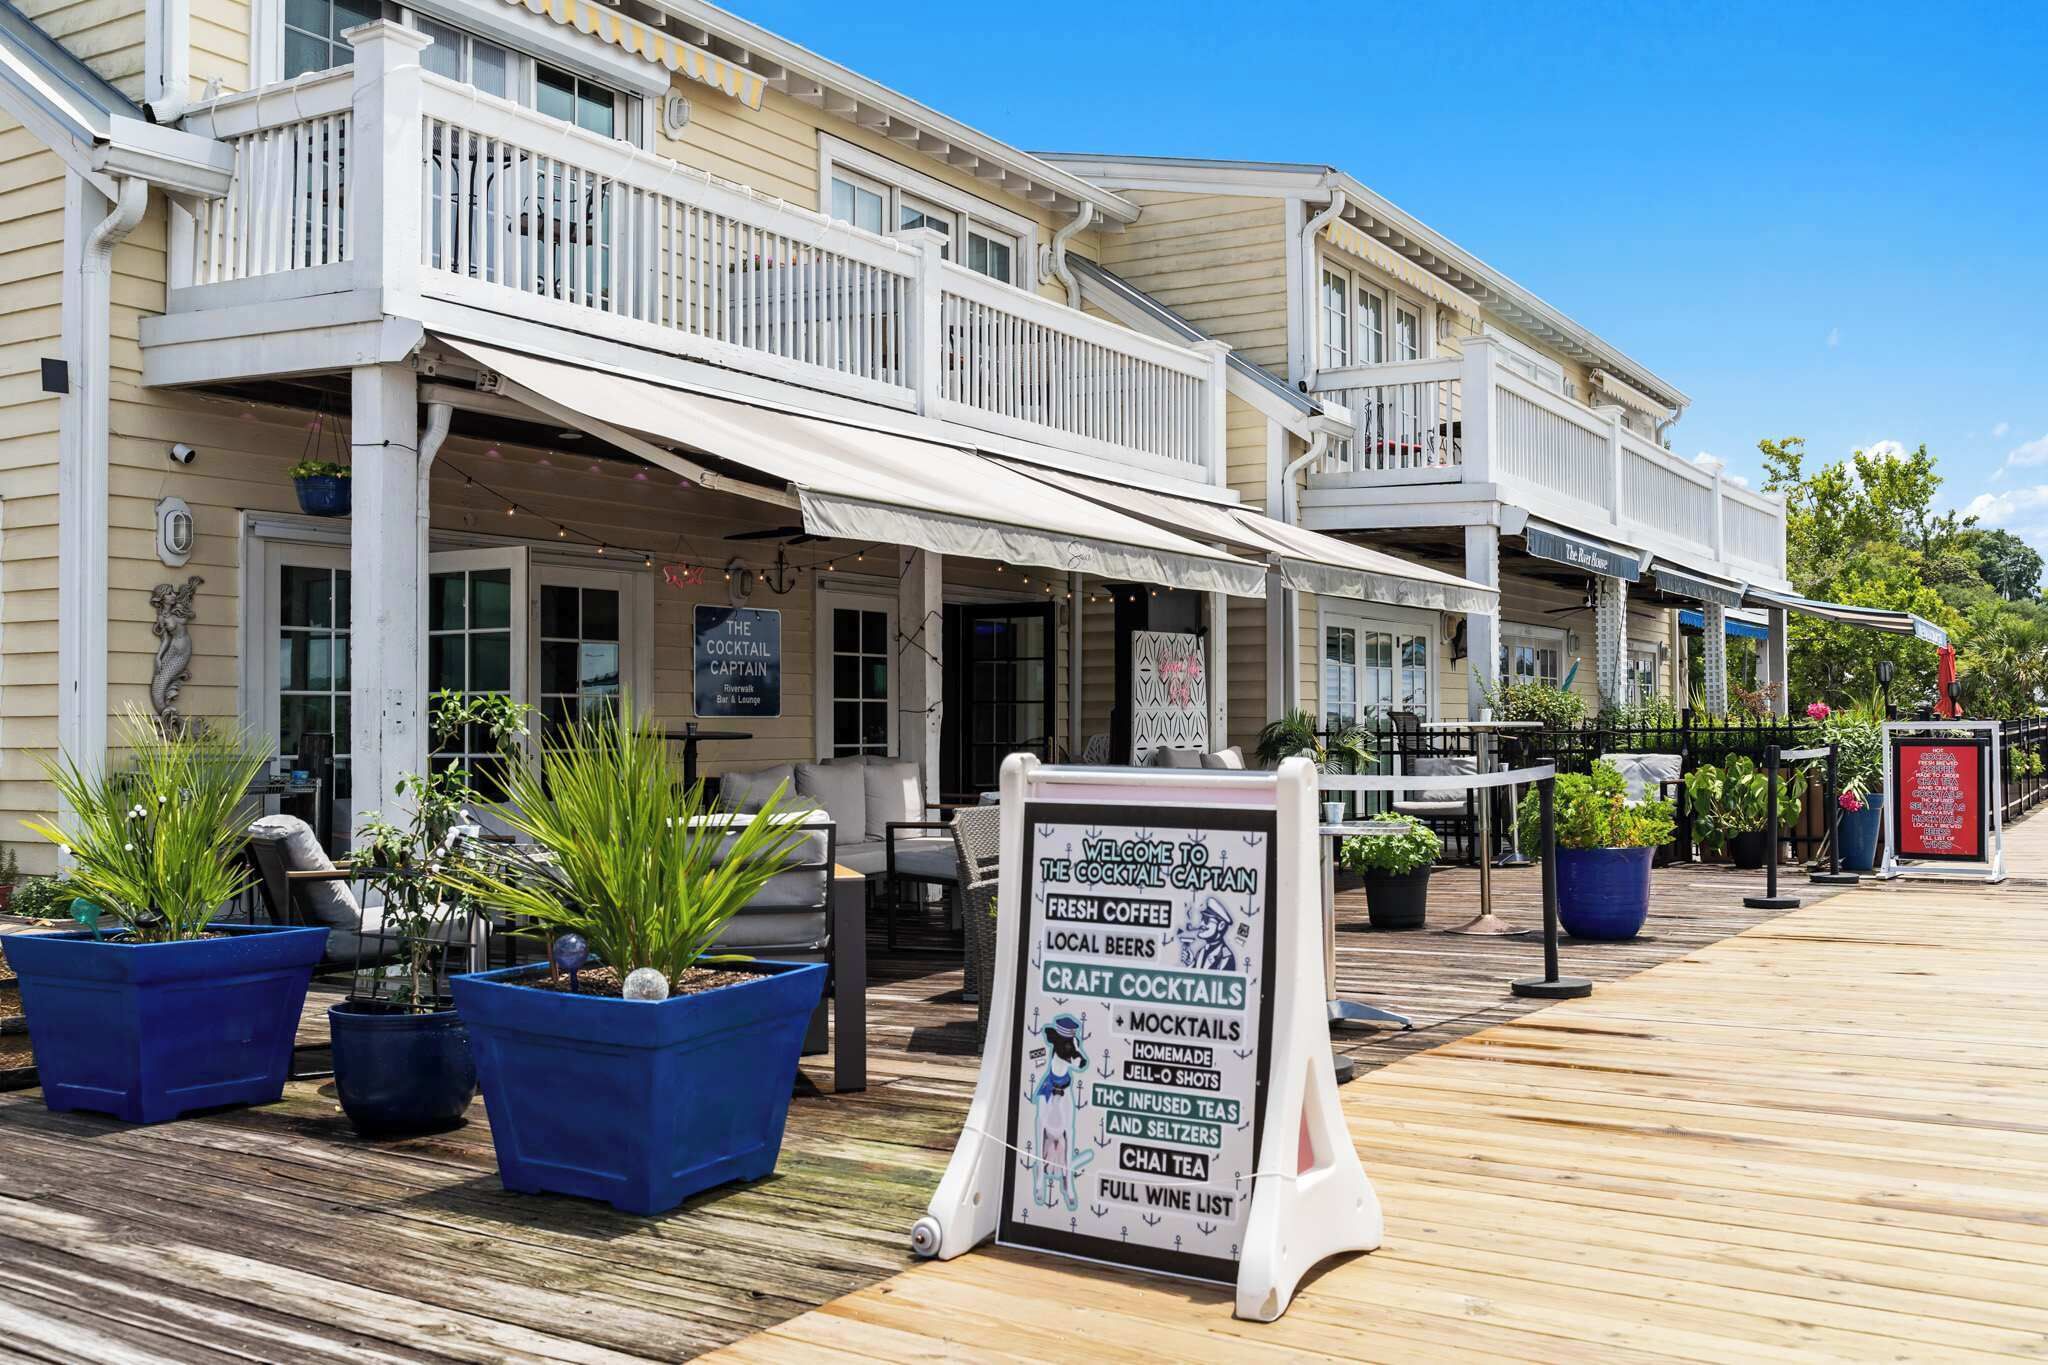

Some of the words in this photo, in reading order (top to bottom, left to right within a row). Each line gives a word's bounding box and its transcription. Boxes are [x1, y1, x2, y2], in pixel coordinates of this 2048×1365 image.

[1566, 544, 1577, 561] The
[726, 620, 751, 636] THE
[706, 639, 771, 657] COCKTAIL
[710, 660, 767, 677] CAPTAIN
[724, 684, 754, 693] Riverwalk
[716, 695, 728, 704] Bar
[731, 695, 736, 704] &
[738, 695, 761, 707] Lounge
[1920, 753, 1956, 761] COCOA
[1920, 765, 1955, 773] COFFEE
[1917, 777, 1938, 785] CHAI
[1941, 778, 1959, 786] TEA
[1912, 790, 1963, 799] COCKTAILS
[1912, 814, 1963, 824] MOCKTAILS
[1924, 828, 1951, 836] BEERS
[1083, 839, 1173, 864] WELCOME
[1181, 843, 1208, 867] TO
[1923, 840, 1953, 849] WINES
[1041, 859, 1070, 882] THE
[1075, 861, 1166, 887] COCKTAIL
[1171, 864, 1257, 893] CAPTAIN
[1048, 898, 1098, 920] FRESH
[1103, 902, 1170, 925] COFFEE
[1047, 932, 1100, 954] LOCAL
[1105, 936, 1155, 958] BEERS
[1046, 967, 1113, 994] CRAFT
[1120, 974, 1243, 1006] COCKTAILS
[1130, 1012, 1241, 1041] MOCKTAILS
[1135, 1043, 1211, 1065] HOMEMADE
[1125, 1065, 1171, 1084] JELL-O
[1175, 1068, 1220, 1089] SHOTS
[1095, 1087, 1125, 1104] THC
[1129, 1091, 1192, 1114] INFUSED
[1197, 1098, 1238, 1121] TEAS
[1109, 1116, 1143, 1135] AND
[1147, 1119, 1220, 1145] SELTZERS
[1122, 1149, 1167, 1170] CHAI
[1172, 1155, 1206, 1178] TEA
[1100, 1180, 1138, 1203] FULL
[1146, 1186, 1191, 1210] WINE
[1197, 1194, 1233, 1217] LIST
